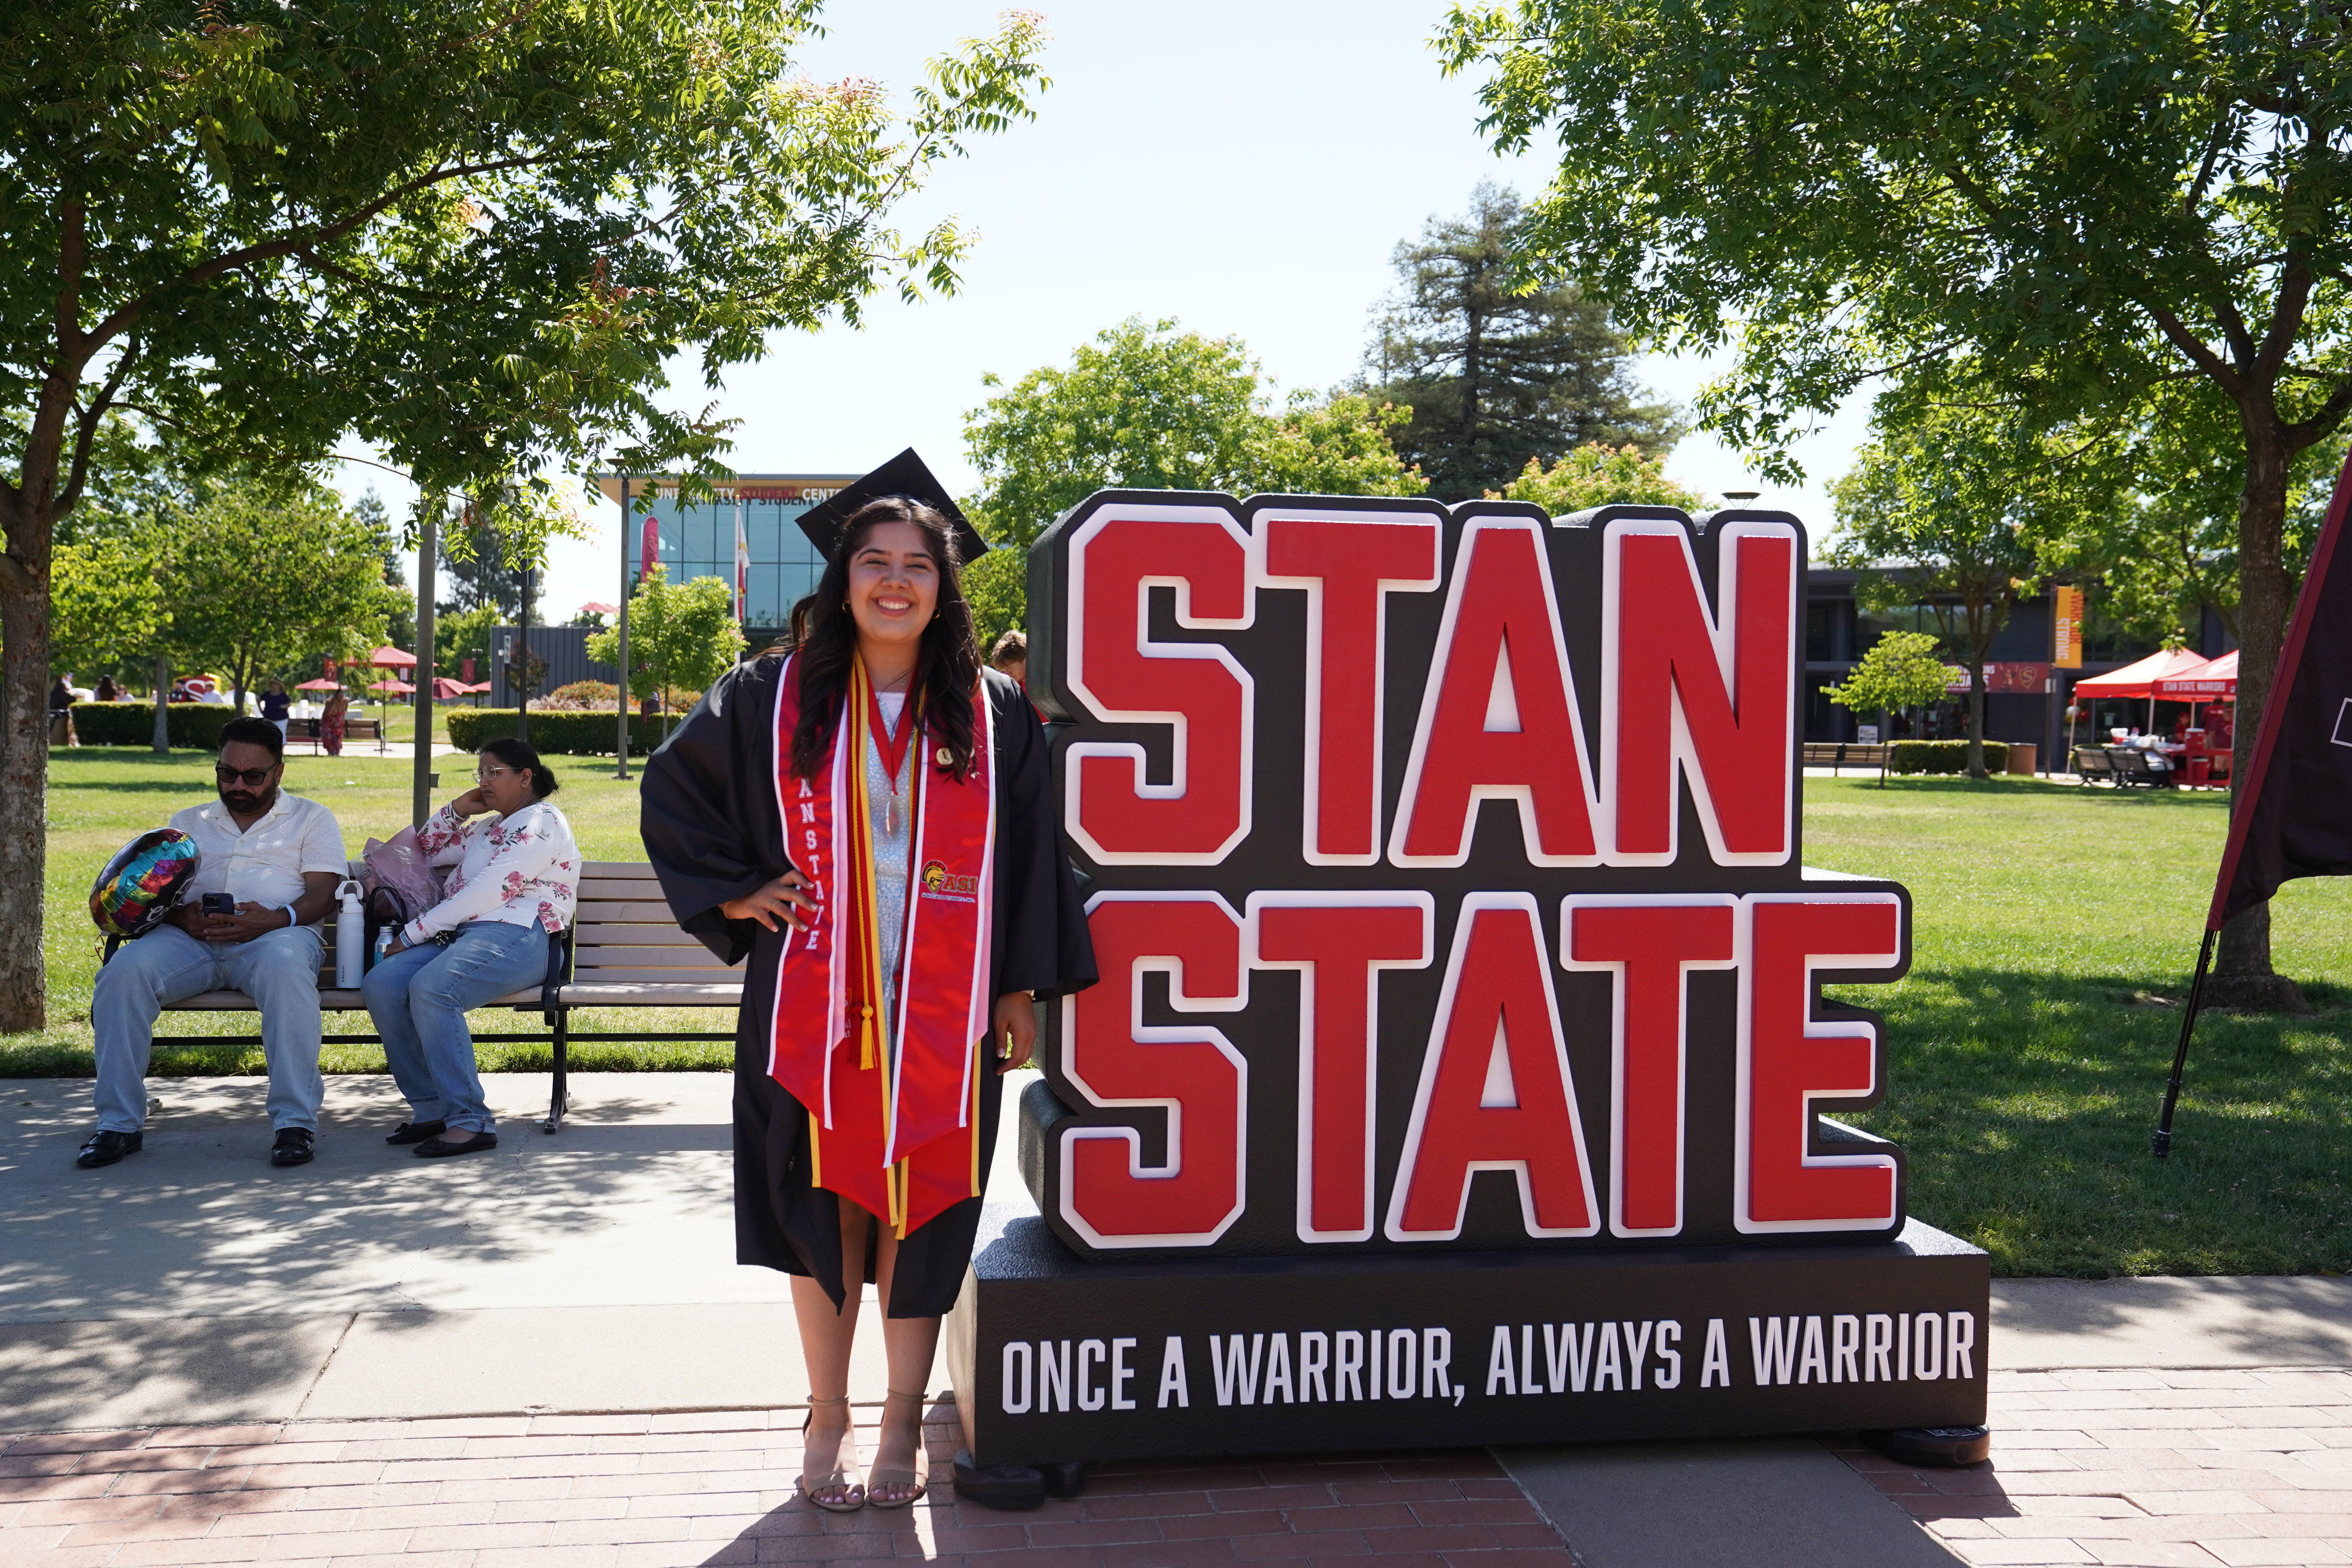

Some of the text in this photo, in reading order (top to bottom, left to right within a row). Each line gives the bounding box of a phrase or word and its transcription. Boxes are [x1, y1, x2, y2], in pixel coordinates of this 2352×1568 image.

[739, 488, 797, 500] STUDENT
[802, 488, 846, 501] CENT
[2056, 617, 2071, 660] STRONG
[1065, 503, 1798, 867] STAN
[2163, 681, 2178, 691] STAN
[2178, 681, 2196, 691] STATE
[2196, 681, 2226, 692] WARRIORS
[942, 874, 978, 894] ASI
[1058, 889, 1902, 1249] STATE
[1002, 1311, 1975, 1414] ONCE A WARRIOR, ALWAYS A WARRIOR
